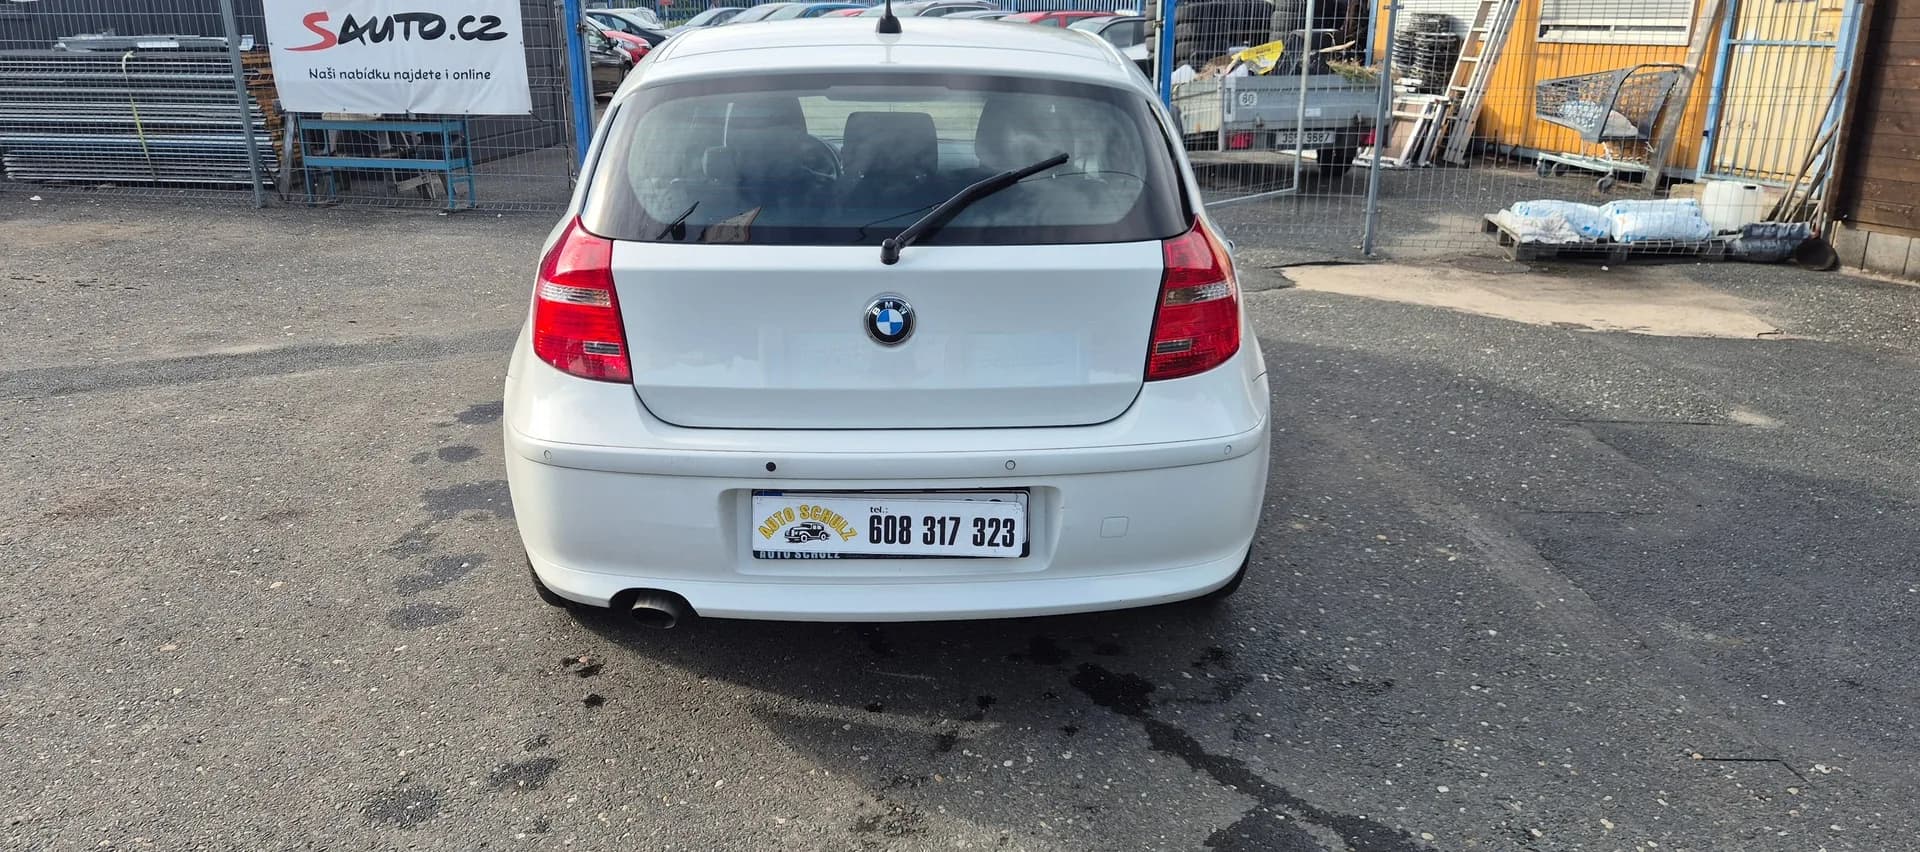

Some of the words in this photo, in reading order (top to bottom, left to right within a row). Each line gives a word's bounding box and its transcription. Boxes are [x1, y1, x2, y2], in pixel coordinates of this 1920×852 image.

[308, 67, 336, 80] Naši
[340, 67, 390, 80] nabídku
[394, 68, 441, 83] najdete
[445, 68, 449, 80] i
[453, 69, 491, 80] online
[872, 301, 908, 315] BMW
[758, 506, 795, 540] AUTO
[799, 504, 858, 542] SCHULZ
[869, 515, 912, 545] 608
[922, 516, 961, 546] 317
[972, 517, 1015, 548] 323
